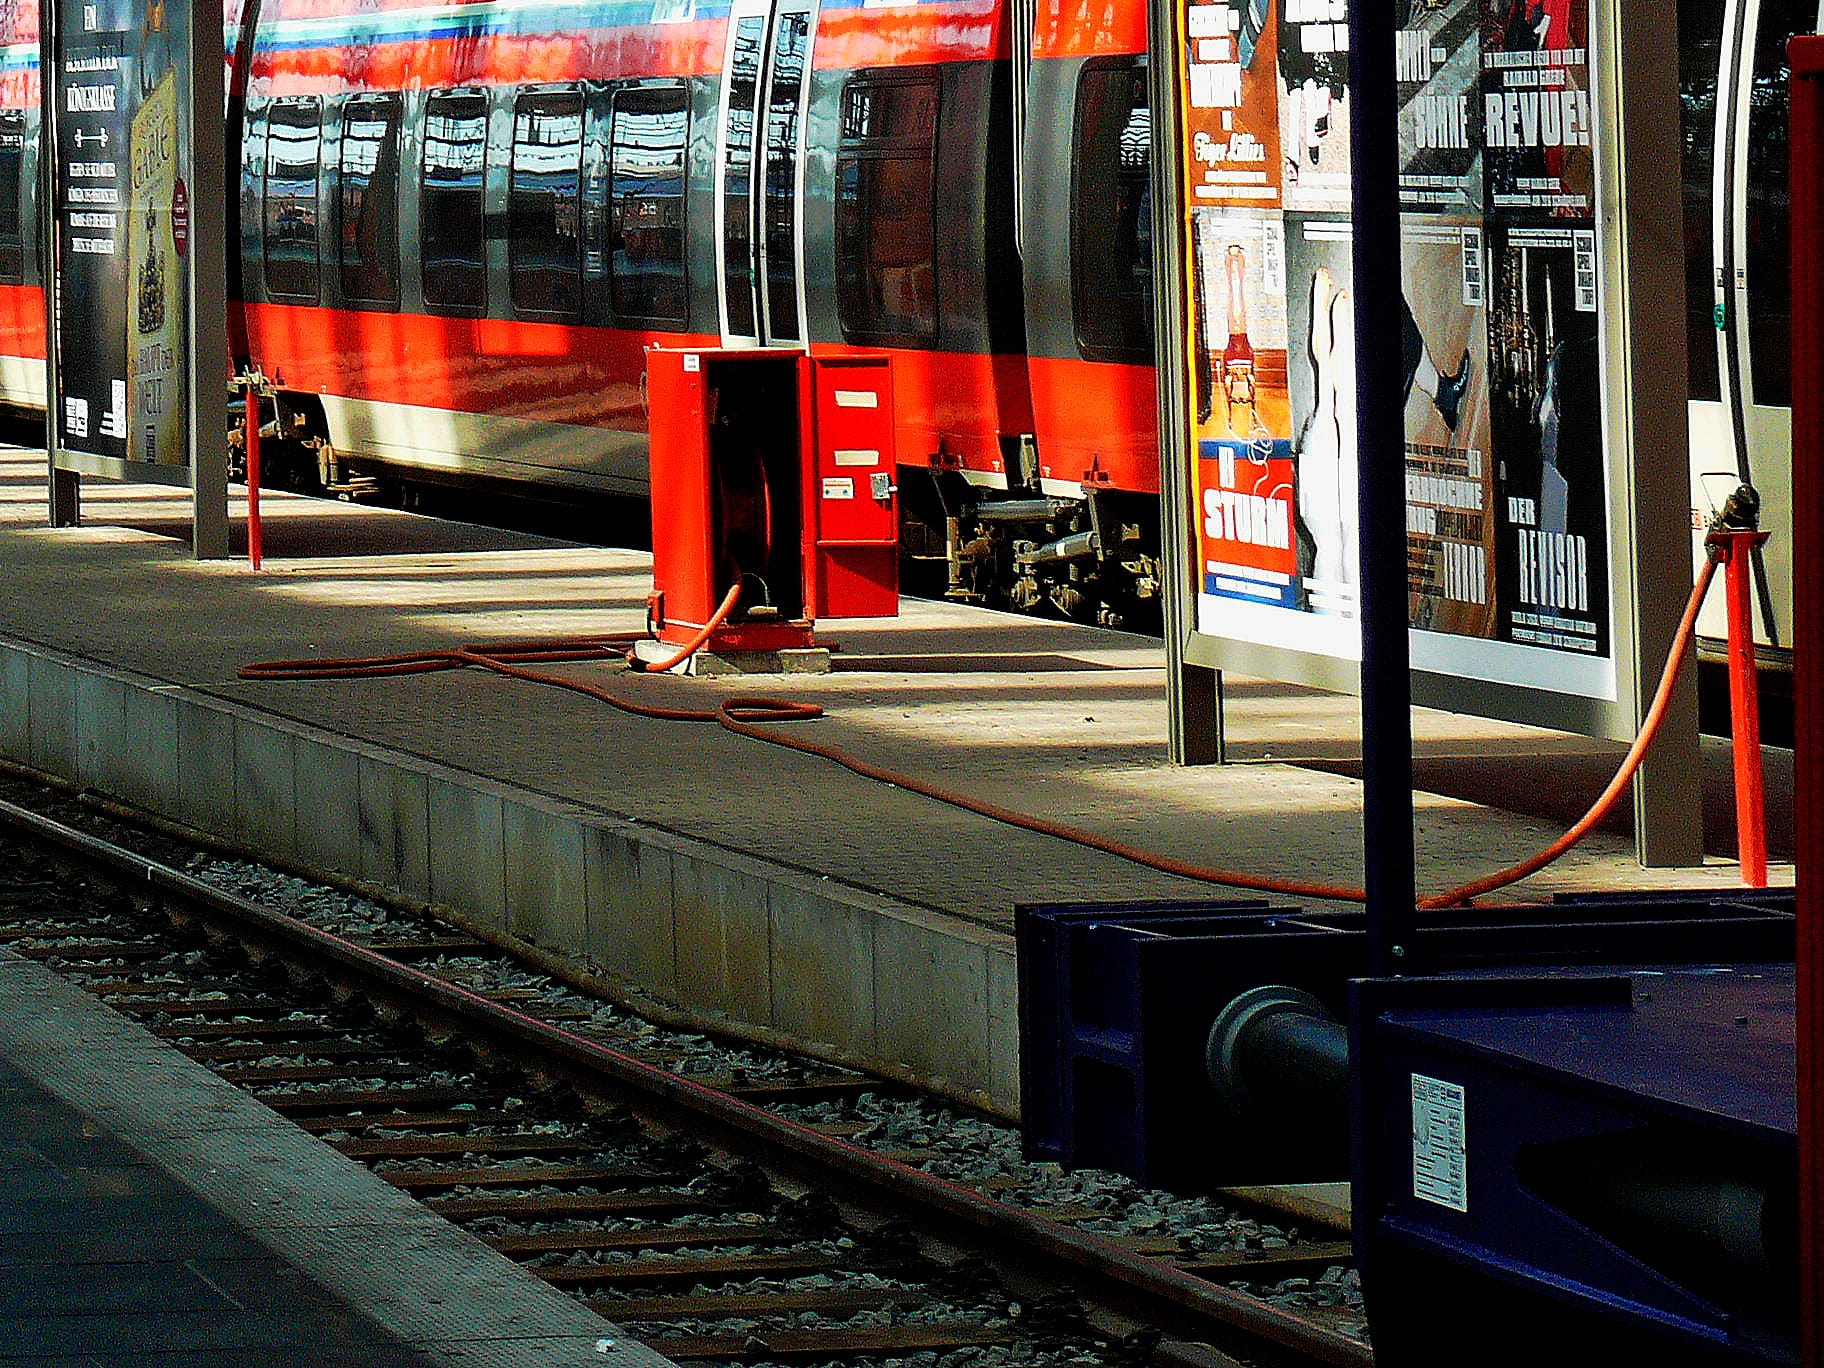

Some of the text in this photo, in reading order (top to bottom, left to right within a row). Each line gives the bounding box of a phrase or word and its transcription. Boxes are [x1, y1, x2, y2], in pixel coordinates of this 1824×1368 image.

[1485, 90, 1590, 148] REVUE!
[1203, 488, 1290, 551] STURM
[1507, 496, 1536, 526] DER
[1517, 527, 1589, 612] REVISOR
